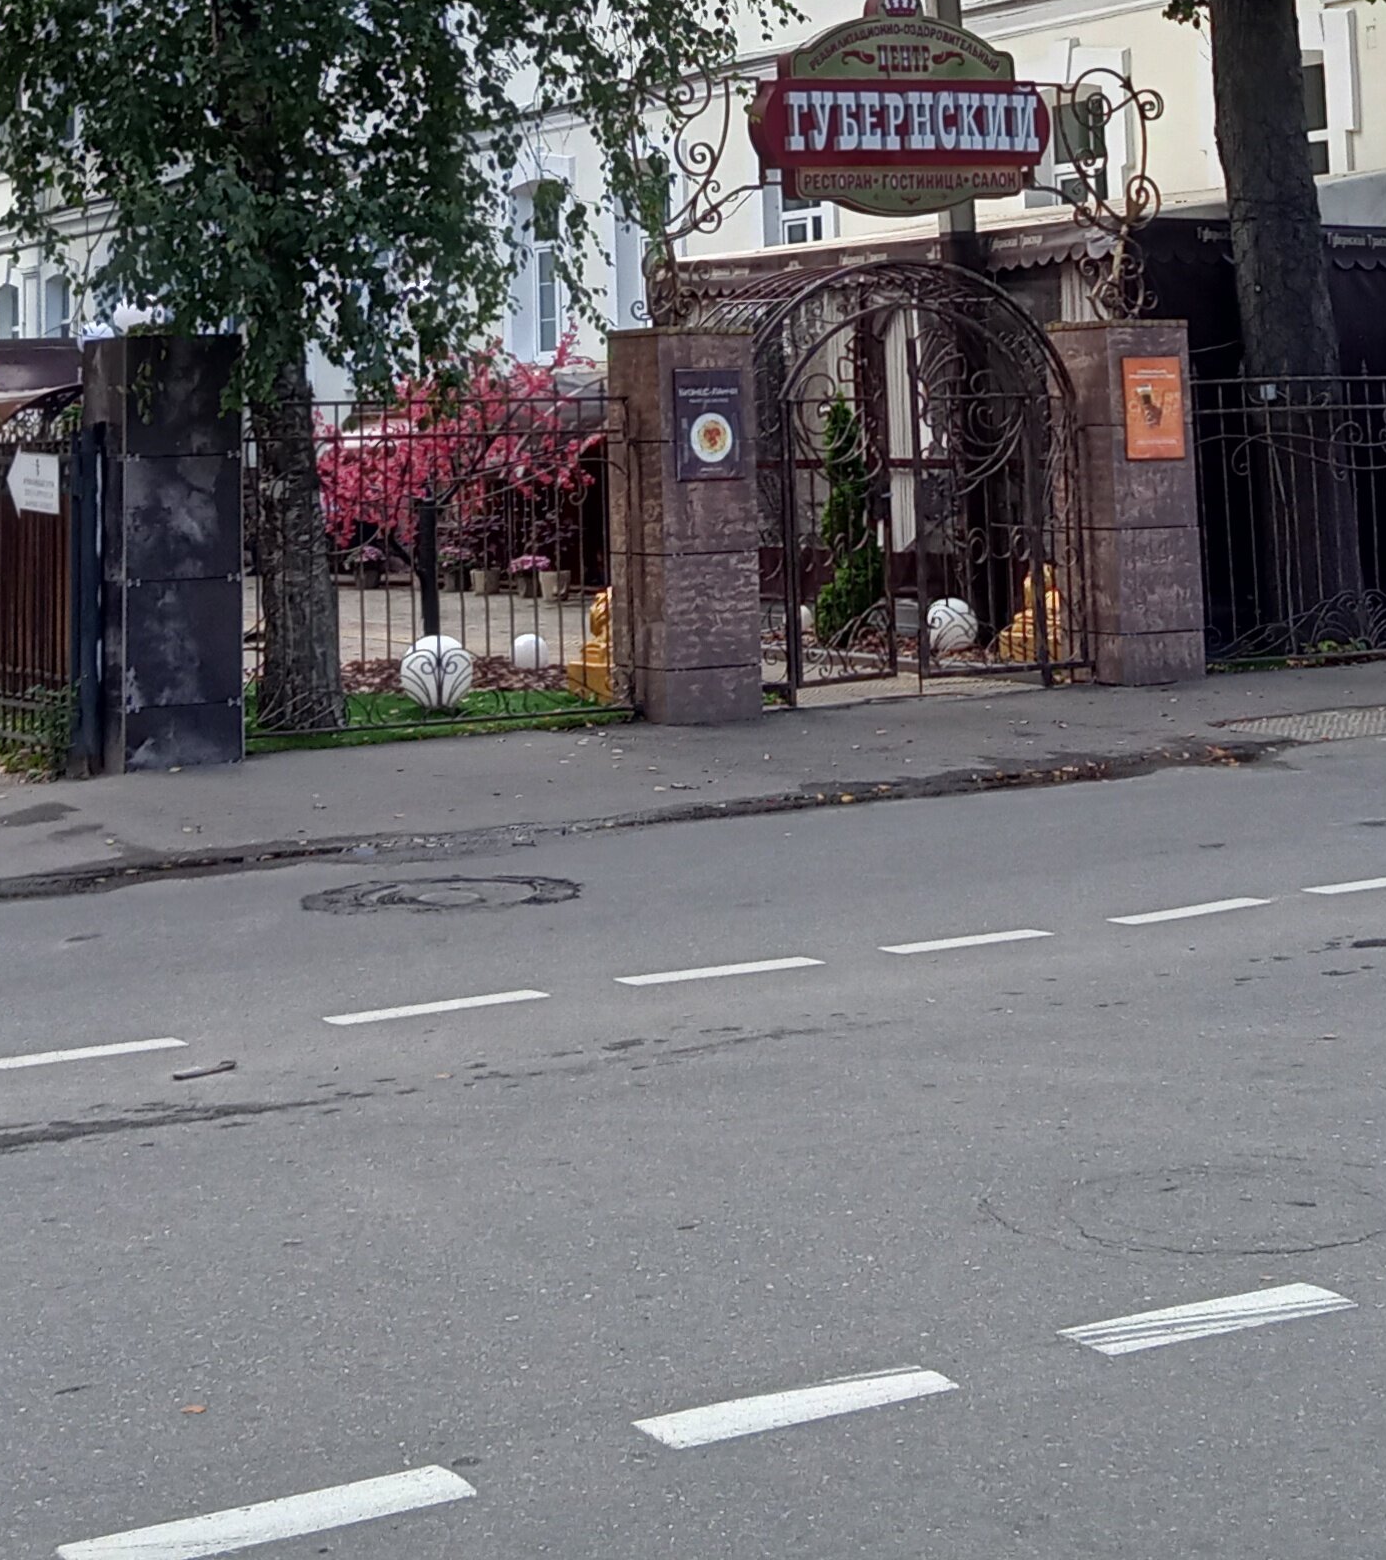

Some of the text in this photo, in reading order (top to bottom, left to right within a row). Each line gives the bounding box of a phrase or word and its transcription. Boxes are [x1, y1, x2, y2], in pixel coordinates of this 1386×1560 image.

[808, 23, 1001, 72] РЕАБИЛИТАЦИОННО-ОЗДОРОВИТЕЛЬНЫЙ
[877, 45, 931, 76] ЦЕНТР
[785, 85, 1040, 152] ГУБЕРНСКИЙ
[804, 172, 1016, 192] РЕСТОРАН ГОСТИНИЦА САЛОН
